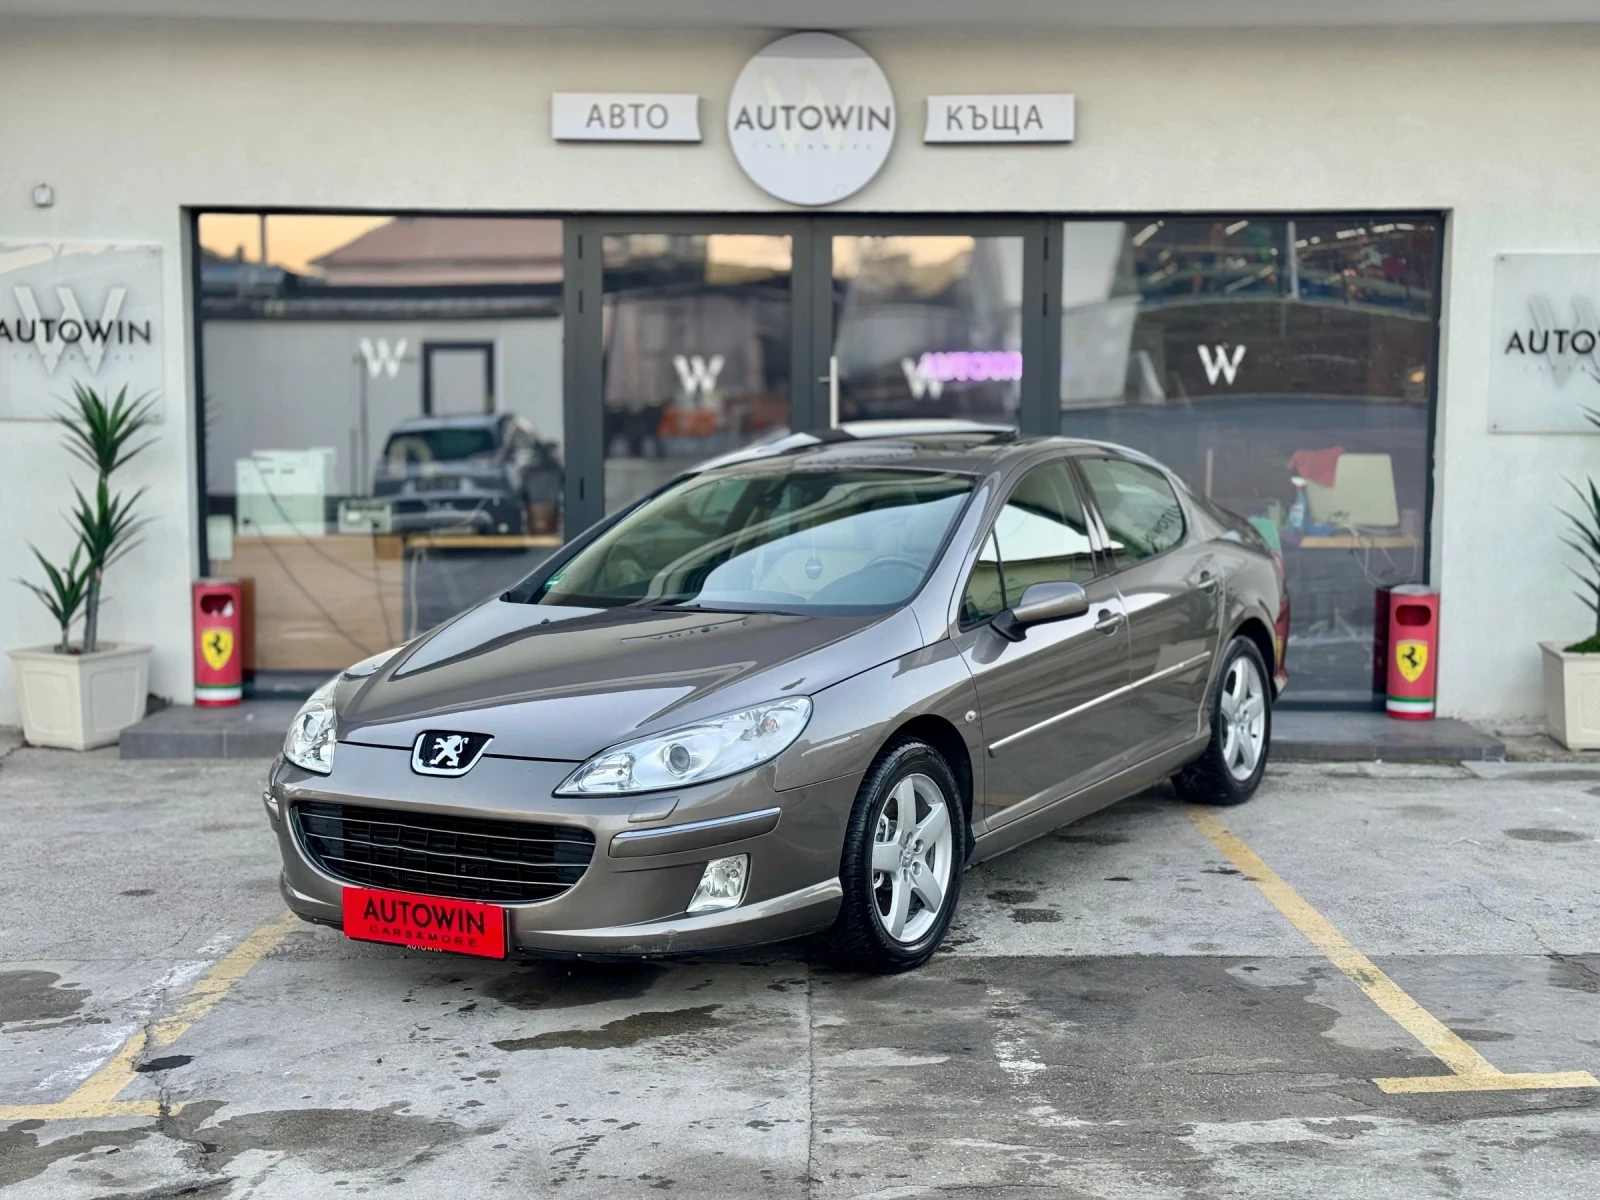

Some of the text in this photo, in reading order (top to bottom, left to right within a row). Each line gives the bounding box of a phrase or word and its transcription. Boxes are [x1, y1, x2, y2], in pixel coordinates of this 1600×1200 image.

[585, 103, 669, 129] АВТО
[734, 105, 891, 131] AUTOWIN
[946, 104, 1043, 135] КЪЩА
[0, 318, 152, 345] AUTOWIN
[1504, 329, 1600, 355] AUTO
[359, 337, 408, 379] W
[1197, 344, 1246, 386] W
[673, 354, 725, 396] W
[363, 896, 486, 936] AUTOWIN
[369, 925, 478, 947] CARS&MORE
